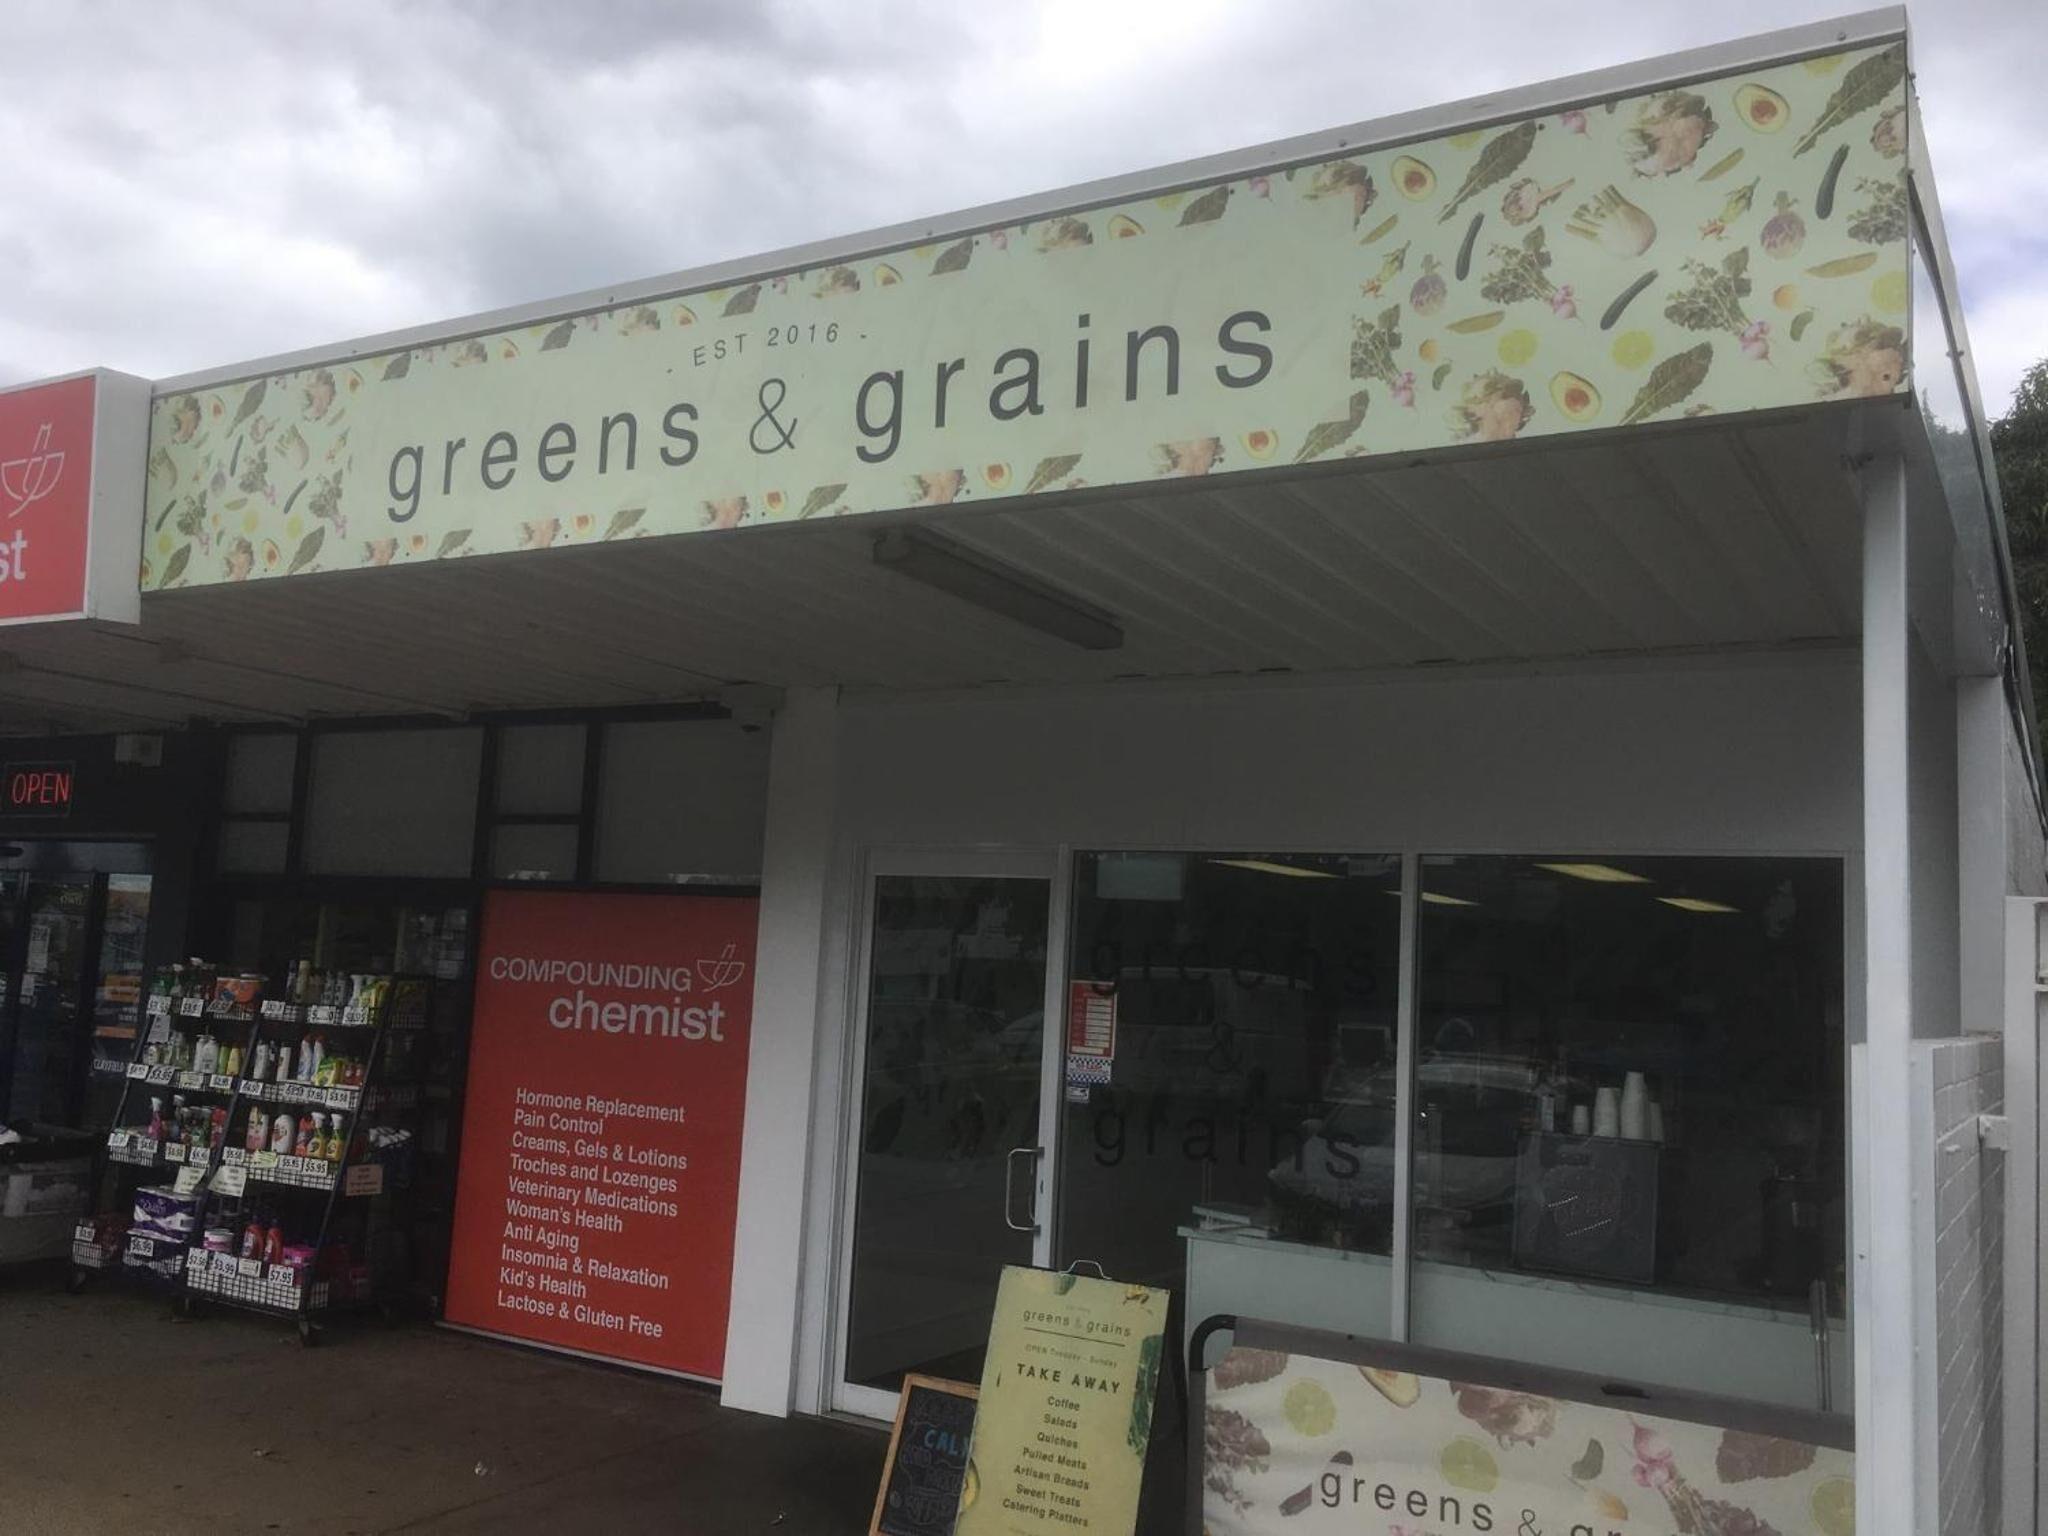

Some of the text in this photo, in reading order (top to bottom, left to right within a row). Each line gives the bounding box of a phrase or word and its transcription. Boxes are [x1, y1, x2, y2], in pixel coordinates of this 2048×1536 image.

[693, 321, 841, 368] EST 2016
[387, 310, 1275, 524] greens & grains
[11, 771, 72, 806] OPEN
[489, 957, 692, 992] COMPOUNDING
[549, 990, 725, 1042] chemist
[514, 1109, 604, 1135] Pain Control
[516, 1088, 686, 1123] Hormone Replacement
[512, 1131, 688, 1170] Creams, Gels & Lotions
[1093, 1097, 1361, 1179] grains
[510, 1154, 678, 1195] Troches and Lozenges
[508, 1176, 678, 1217] Veterinary Medications
[506, 1198, 624, 1233] Woman's Health
[504, 1221, 580, 1254] Anti Aging
[270, 1269, 293, 1285] $7.95
[500, 1266, 587, 1299] Kid's Health
[501, 1243, 670, 1290] Insomnia & Relaxation
[497, 1289, 664, 1339] Lactose & Gluten Free
[1022, 1310, 1071, 1328] greens
[1086, 1321, 1132, 1338] grains
[1017, 1363, 1121, 1393] TAKE AWAY
[1047, 1396, 1081, 1411] Coffee
[1043, 1413, 1078, 1430] Salads
[1037, 1431, 1079, 1449] Quiches
[1022, 1446, 1087, 1470] Pulled Meats
[1013, 1464, 1089, 1490] Artisan Breads
[1002, 1498, 1089, 1528] Catering Platters
[1016, 1484, 1081, 1508] Sweet Treats
[1318, 1471, 1495, 1533] greens
